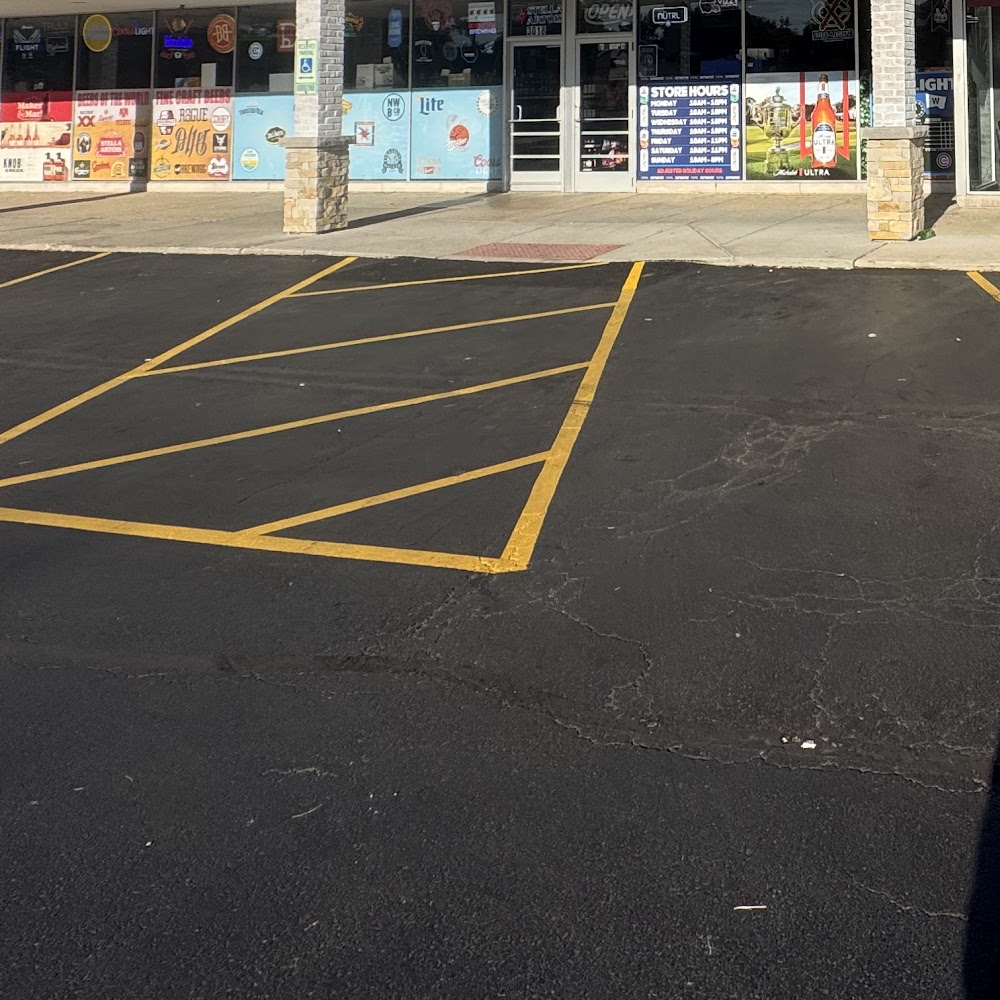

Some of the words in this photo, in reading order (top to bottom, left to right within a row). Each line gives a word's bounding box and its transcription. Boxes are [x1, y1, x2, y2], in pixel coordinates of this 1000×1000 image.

[587, 3, 632, 20] OPEN
[650, 86, 688, 98] STORE
[689, 85, 729, 97] HOURS
[420, 97, 444, 115] Lite
[3, 158, 22, 168] KNOB
[804, 168, 829, 176] ULTRA
